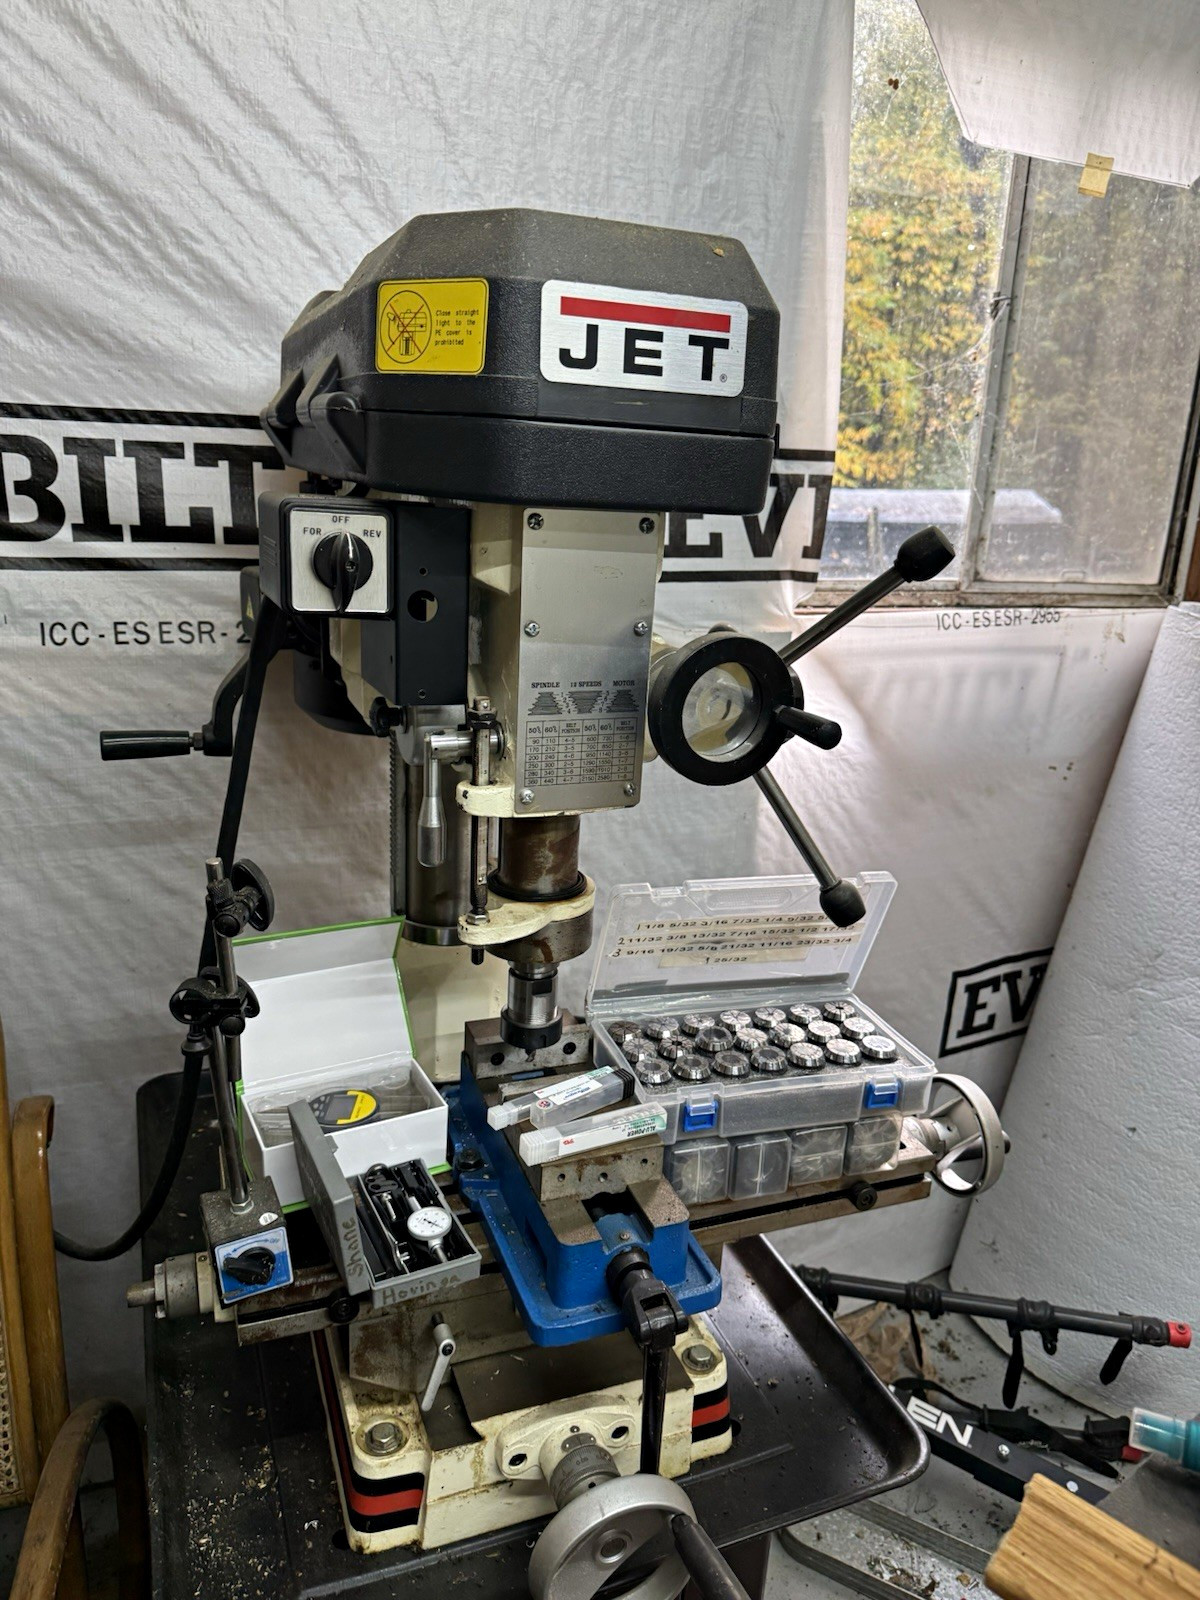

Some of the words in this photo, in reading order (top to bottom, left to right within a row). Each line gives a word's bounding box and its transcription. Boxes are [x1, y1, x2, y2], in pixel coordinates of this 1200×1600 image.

[456, 309, 479, 317] straight
[436, 319, 450, 327] light
[559, 324, 730, 382] JET
[332, 515, 351, 524] OFF
[303, 527, 322, 536] FOR
[363, 529, 382, 538] REV
[618, 937, 625, 945] 2
[612, 948, 621, 958] 3
[626, 948, 655, 956] 9/16
[796, 938, 830, 946] 23/32
[342, 1217, 363, 1277] Shane
[382, 1275, 461, 1305] Hovinga
